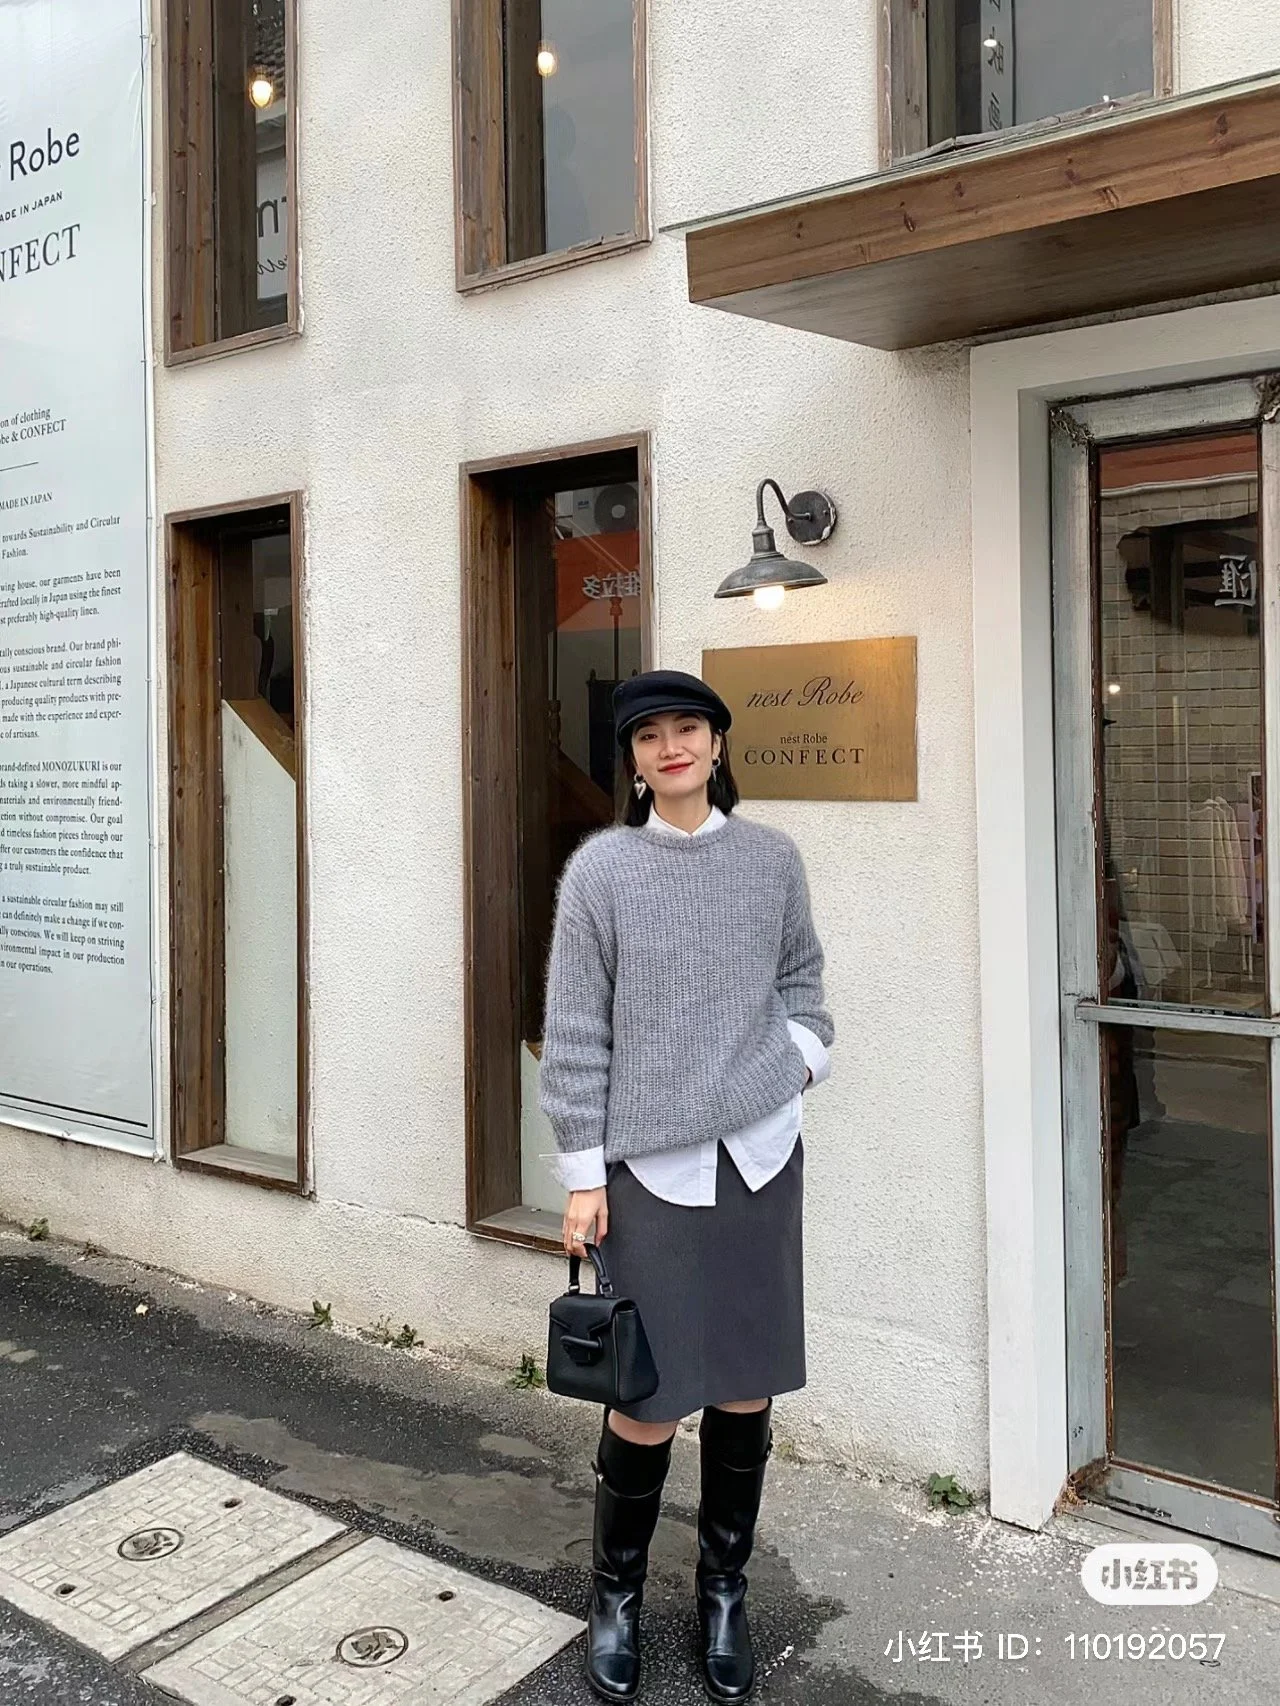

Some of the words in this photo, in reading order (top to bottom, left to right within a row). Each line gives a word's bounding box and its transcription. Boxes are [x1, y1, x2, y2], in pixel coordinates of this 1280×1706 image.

[10, 128, 80, 181] Robe
[20, 204, 29, 215] IN
[32, 191, 63, 211] JAPAN
[1, 419, 9, 428] on
[11, 413, 19, 425] of
[20, 409, 50, 423] clothing
[11, 431, 18, 442] &
[20, 419, 66, 440] CONFECT
[21, 496, 29, 507] IN
[30, 492, 53, 505] JAPAN
[2, 530, 27, 543] towards
[29, 522, 73, 538] Sustainability
[76, 520, 88, 530] and
[90, 515, 120, 528] Circular
[2, 548, 28, 559] Fashion.
[53, 575, 83, 588] garments
[86, 571, 101, 580] have
[104, 569, 121, 578] been
[21, 595, 40, 606] locally
[42, 594, 48, 603] in
[49, 592, 67, 605] Japan
[69, 590, 87, 601] using
[89, 588, 100, 597] the
[101, 586, 121, 597] finest
[8, 611, 38, 627] preferably
[40, 608, 79, 622] high-quality
[80, 606, 99, 615] linen.
[14, 646, 45, 656] conscious
[46, 642, 67, 653] brand.
[69, 641, 83, 651] Our
[85, 639, 105, 650] brand
[13, 661, 48, 672] sustainable
[51, 660, 63, 670] and
[66, 658, 92, 668] circular
[96, 655, 121, 666] fashion
[5, 682, 8, 690] a
[10, 680, 38, 691] Japanese
[40, 677, 65, 687] cultural
[67, 677, 82, 686] term
[84, 674, 121, 686] describing
[2, 696, 33, 708] producing
[35, 695, 56, 706] quality
[59, 693, 88, 705] products
[90, 691, 105, 701] with
[747, 689, 792, 708] nest
[798, 676, 864, 706] Robe
[2, 713, 18, 722] made
[20, 713, 34, 722] with
[36, 712, 46, 721] the
[48, 710, 83, 723] experience
[85, 709, 97, 719] and
[5, 729, 12, 738] of
[13, 729, 39, 738] artisans.
[780, 735, 800, 744] nest
[803, 733, 828, 744] Robe
[745, 748, 864, 765] CONFECT
[42, 761, 100, 771] MONOZUKURI
[102, 761, 108, 771] is
[110, 763, 122, 771] our
[8, 779, 27, 791] taking
[36, 779, 59, 789] slower,
[82, 778, 108, 788] mindful
[28, 795, 40, 805] and
[43, 796, 95, 808] environmentally
[99, 796, 122, 806] friend-
[19, 812, 43, 821] without
[46, 813, 87, 824] compromise.
[90, 813, 104, 823] Our
[107, 814, 122, 826] goal
[7, 828, 31, 838] timeless
[33, 829, 56, 839] fashion
[59, 830, 79, 841] pieces
[81, 830, 108, 844] through
[110, 833, 123, 841] our
[12, 846, 22, 854] our
[24, 847, 56, 855] customers
[58, 846, 69, 856] the
[70, 847, 107, 858] confidence
[108, 849, 123, 859] that
[9, 861, 23, 873] truly
[25, 861, 61, 872] sustainable
[63, 864, 91, 876] product.
[7, 894, 41, 905] sustainable
[42, 898, 67, 907] circular
[69, 898, 93, 909] fashion
[95, 902, 108, 913] may
[110, 902, 124, 912] still
[14, 910, 42, 924] definitely
[44, 914, 60, 924] make
[67, 917, 90, 929] change
[91, 918, 97, 927] if
[98, 920, 107, 928] we
[10, 927, 41, 938] conscious.
[44, 929, 54, 940] We
[56, 931, 68, 942] will
[70, 933, 85, 945] keep
[87, 936, 96, 945] on
[98, 936, 124, 950] striving
[39, 946, 61, 959] impact
[63, 949, 70, 958] in
[73, 952, 84, 961] our
[87, 953, 124, 965] production
[6, 961, 17, 969] our
[18, 961, 53, 973] operations.
